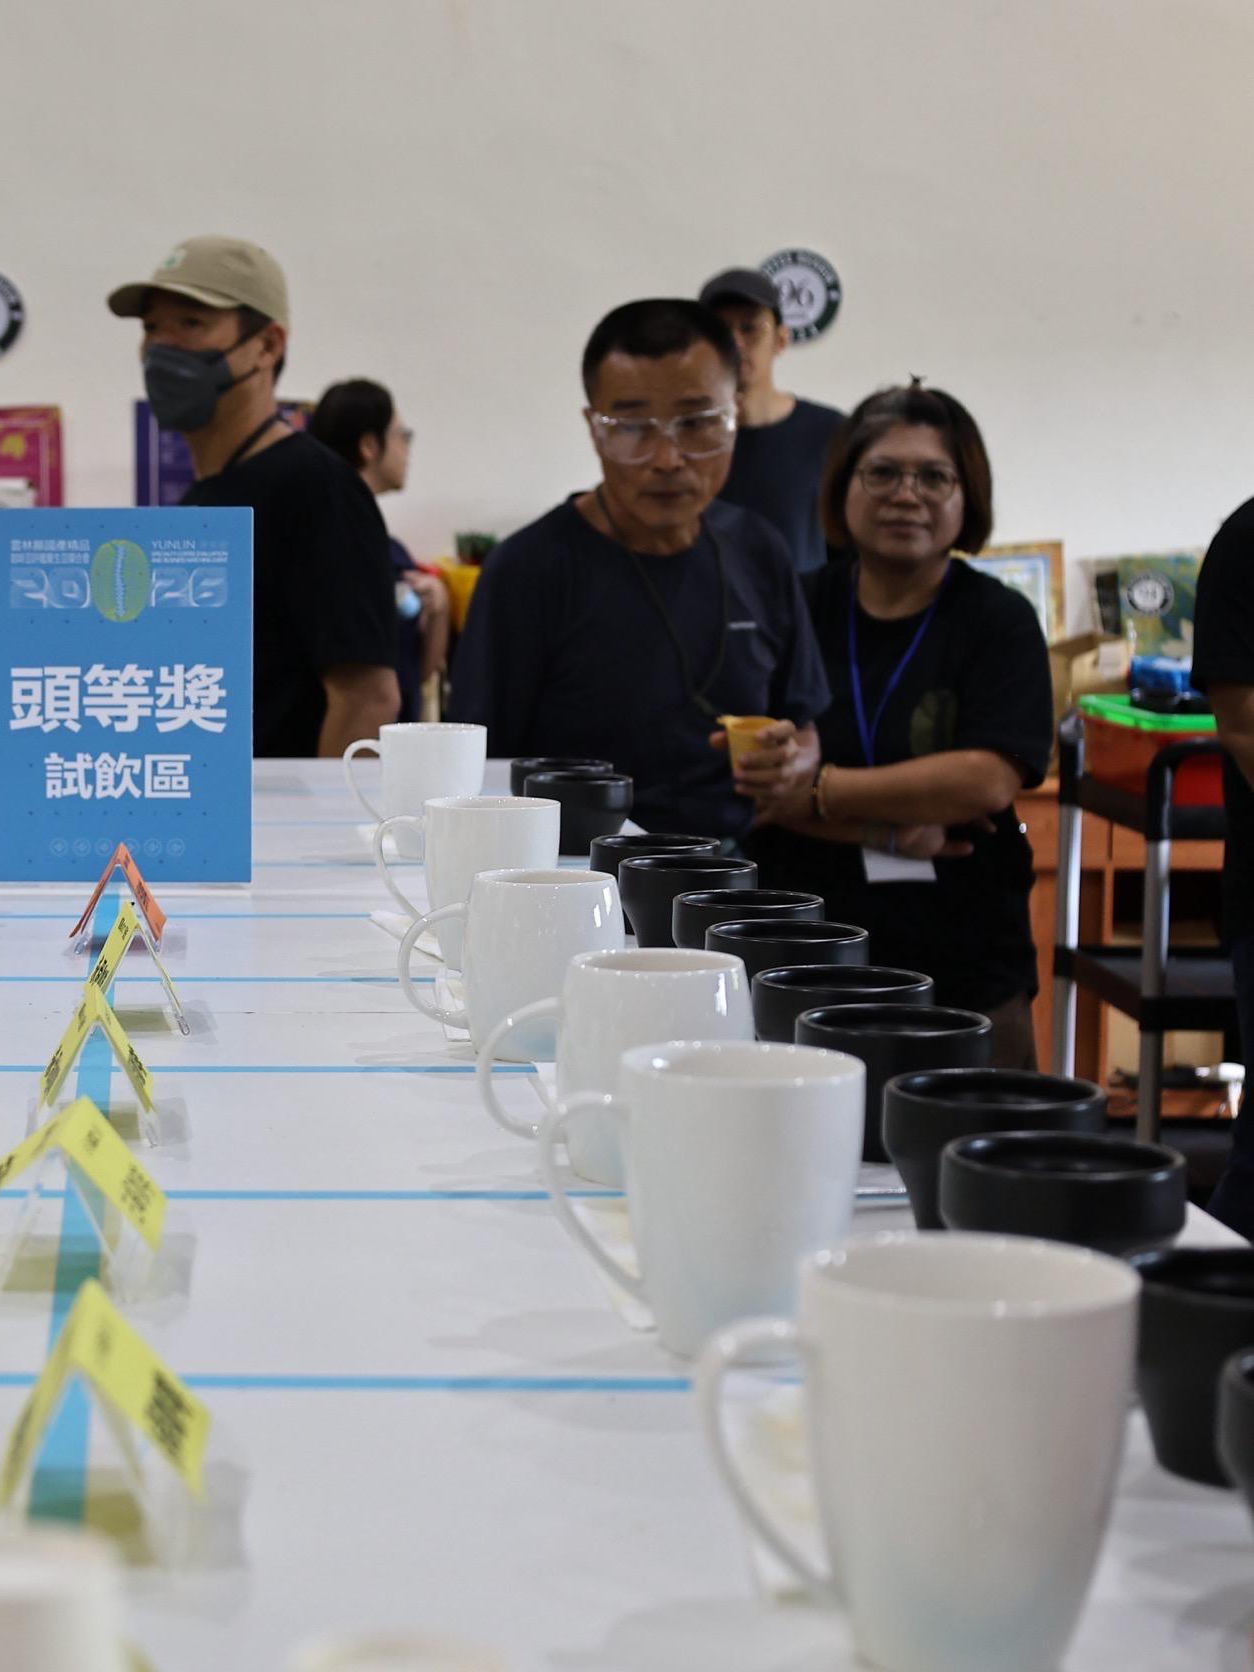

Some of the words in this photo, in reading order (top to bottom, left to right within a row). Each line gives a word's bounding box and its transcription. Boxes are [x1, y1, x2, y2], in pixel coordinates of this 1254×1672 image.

[152, 540, 196, 549] YUNLIN
[9, 663, 228, 734] 頭等獎
[44, 752, 192, 800] 試飲區
